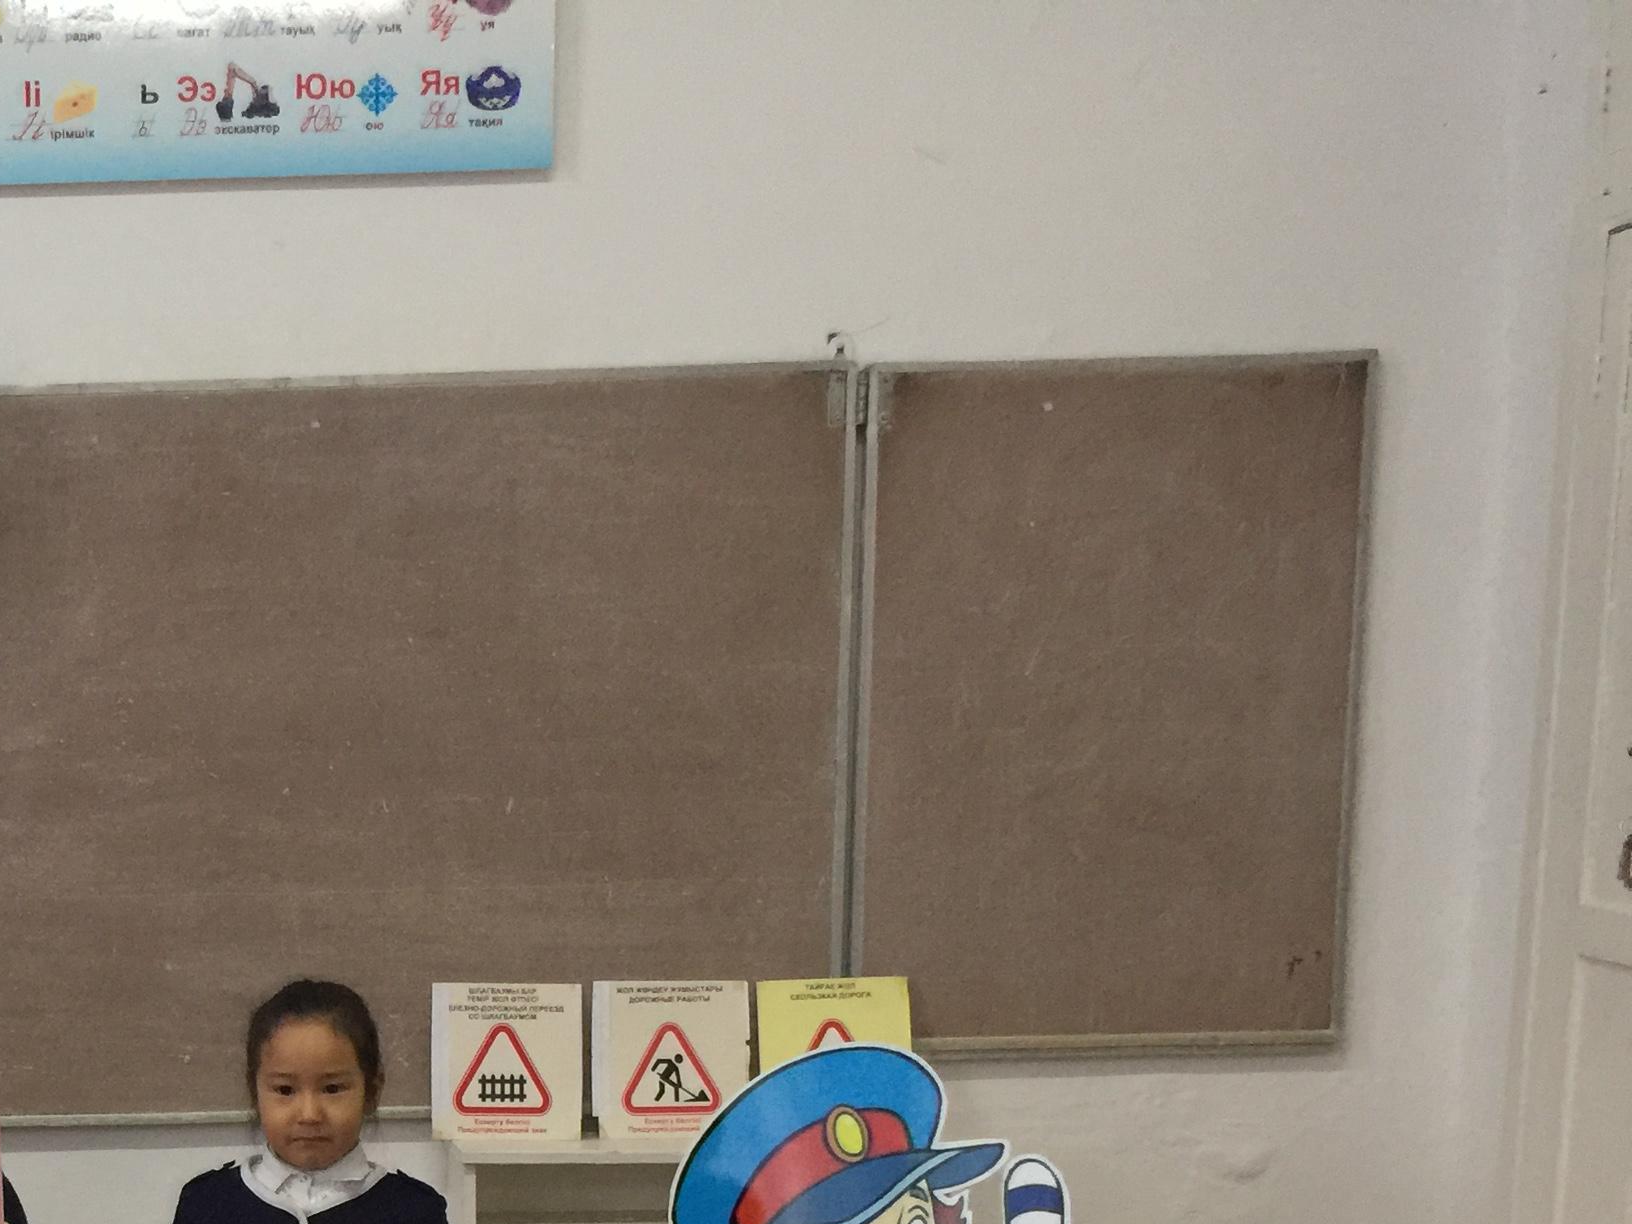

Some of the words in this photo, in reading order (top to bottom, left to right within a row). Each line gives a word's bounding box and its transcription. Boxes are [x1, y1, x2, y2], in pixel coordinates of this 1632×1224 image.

[177, 75, 216, 102] Ээ
[296, 72, 356, 100] Юю
[421, 69, 461, 96] Яя
[215, 123, 281, 135] экскаватор
